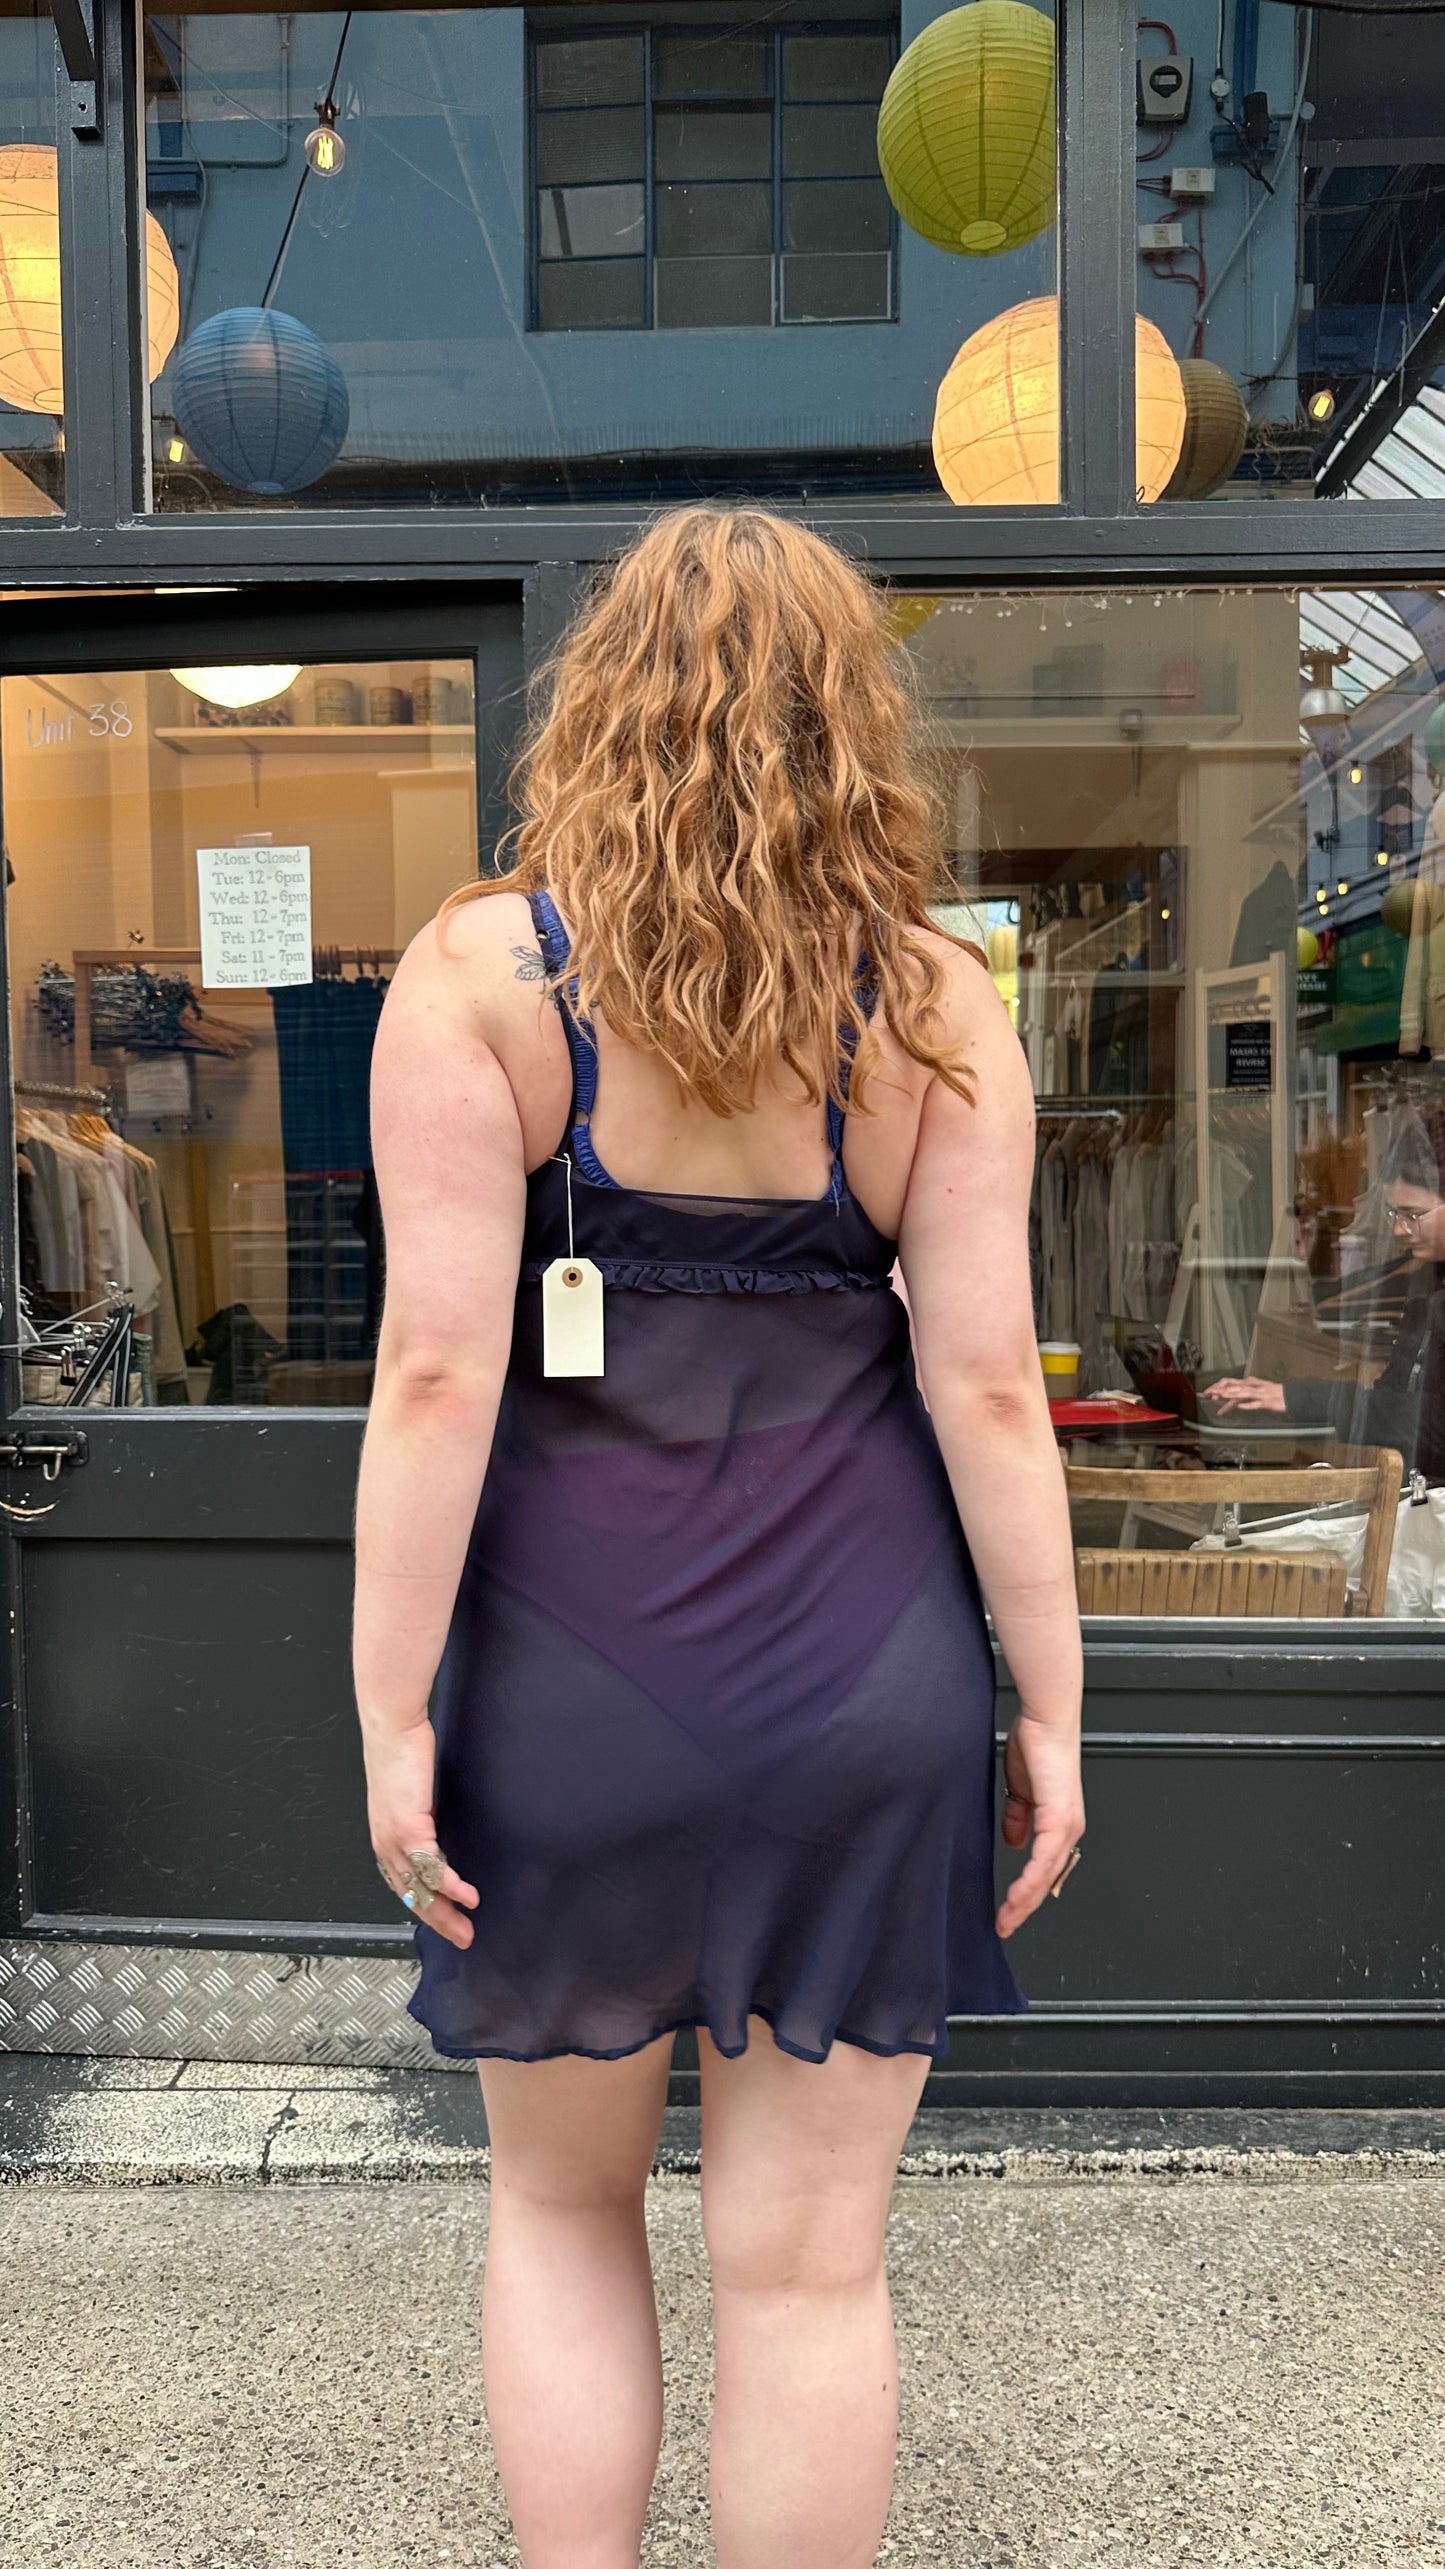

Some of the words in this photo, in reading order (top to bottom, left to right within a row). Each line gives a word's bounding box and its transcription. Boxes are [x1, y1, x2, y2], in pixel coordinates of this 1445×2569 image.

[26, 707, 74, 749] Unit
[89, 700, 133, 738] 38
[213, 852, 251, 866] Mon:
[255, 850, 302, 864] Closed
[211, 872, 244, 885] Tue:
[209, 891, 249, 905] Wed:
[208, 911, 244, 925] Thu:
[220, 931, 246, 945] Fri:
[221, 951, 248, 964] Sat:
[215, 970, 249, 984] Sun:
